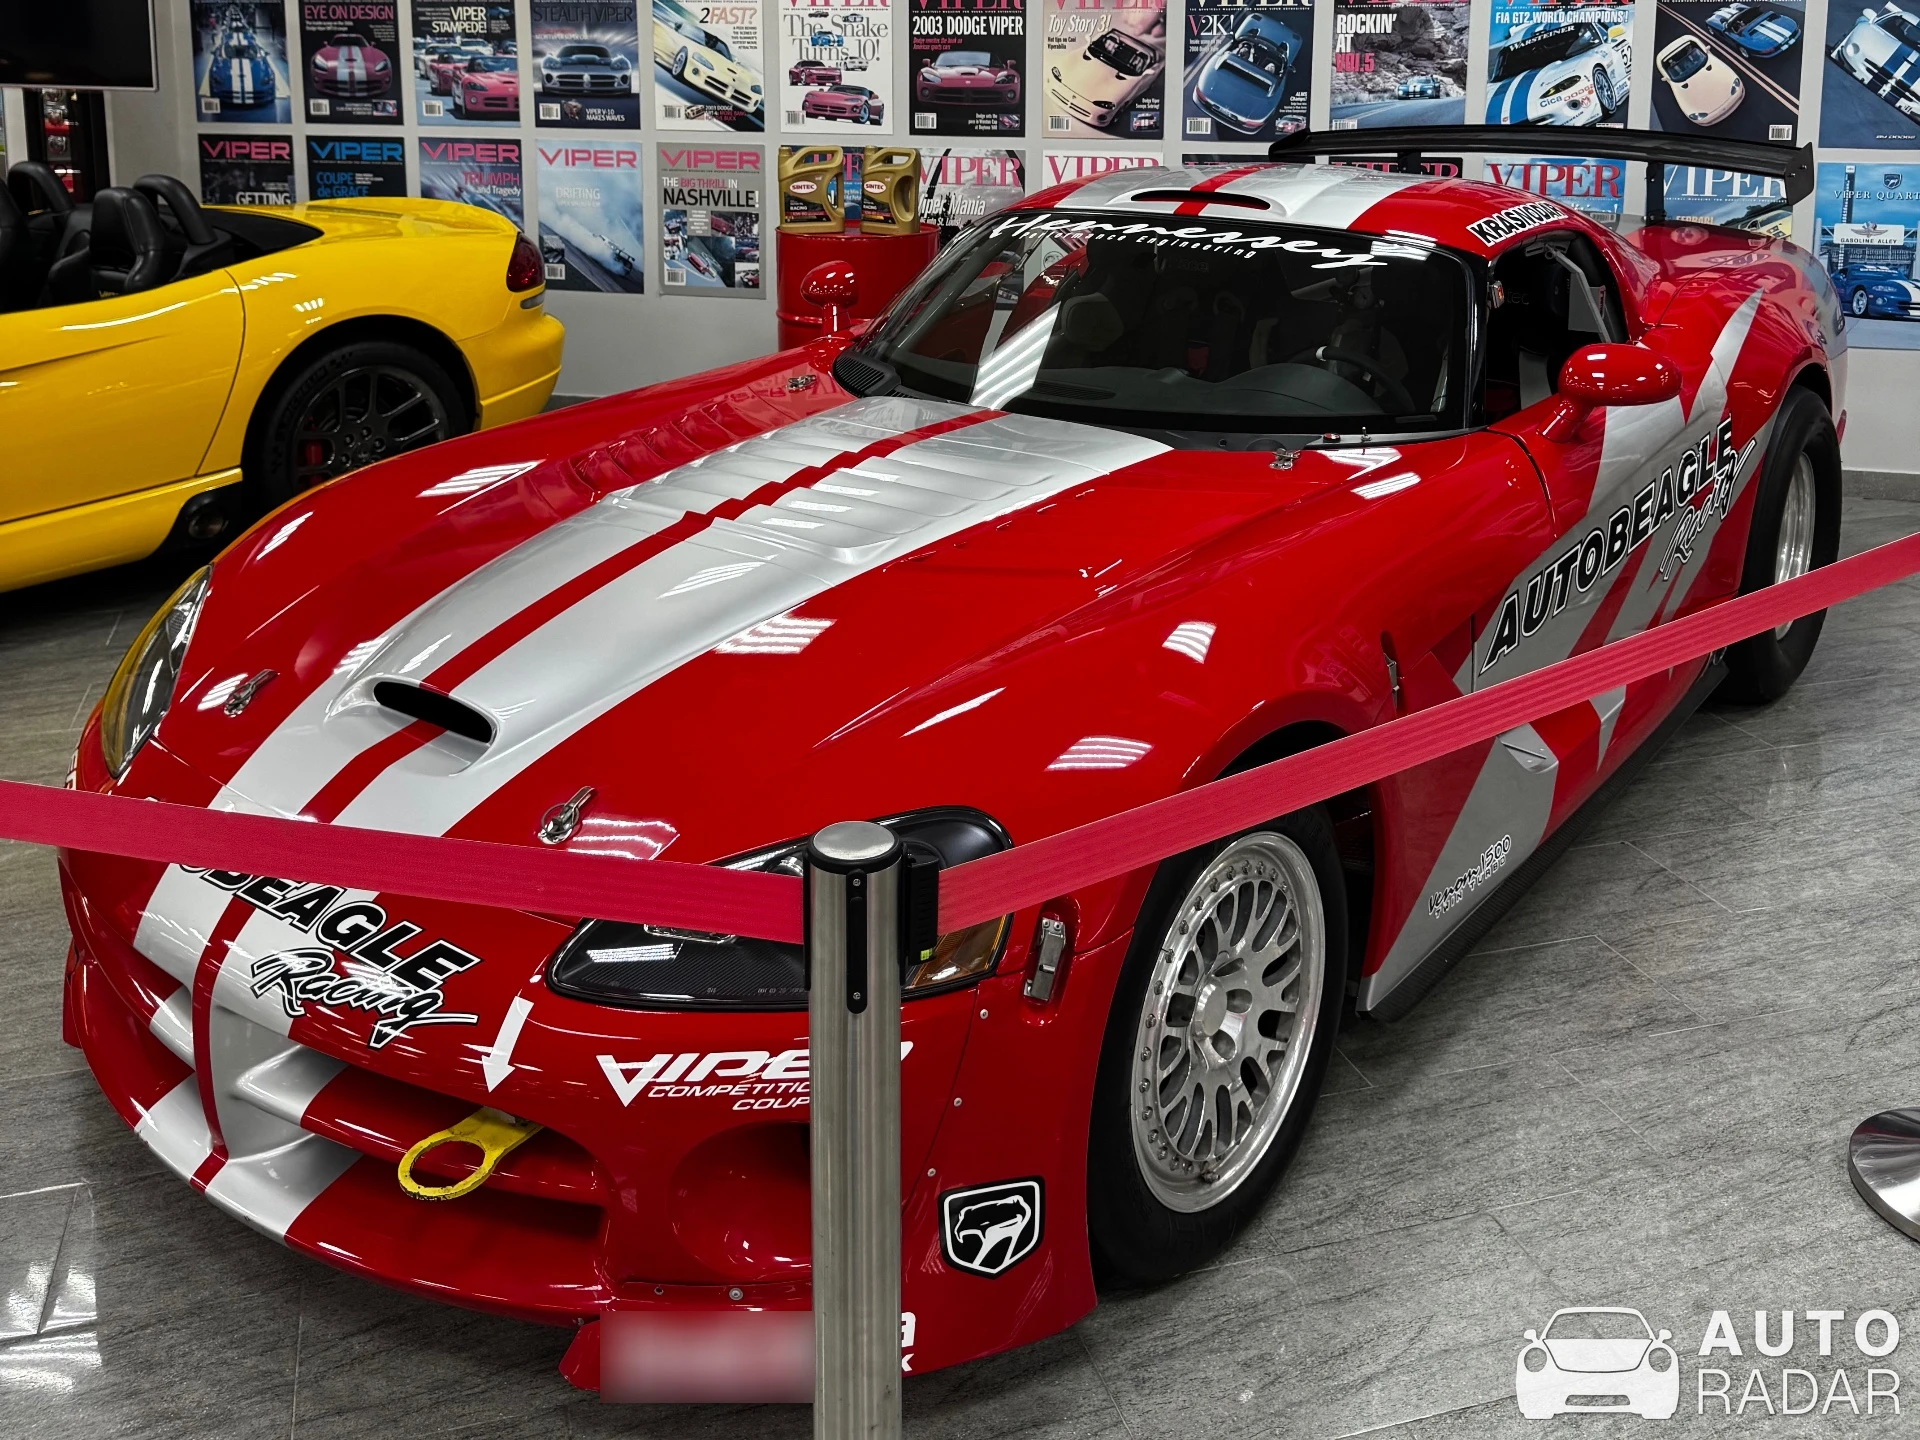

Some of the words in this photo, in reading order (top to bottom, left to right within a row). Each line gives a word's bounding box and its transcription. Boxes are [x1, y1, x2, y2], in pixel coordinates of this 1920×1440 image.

[304, 5, 328, 19] EYE
[329, 6, 349, 20] ON
[350, 6, 394, 20] DESIGN
[450, 7, 487, 20] VIPER
[533, 6, 592, 22] STEALTH
[594, 7, 633, 22] VIPER
[1495, 11, 1511, 24] FIA
[1512, 11, 1529, 24] GT2
[1532, 11, 1565, 23] WORLD
[432, 21, 488, 34] STAMPEDE!
[783, 14, 823, 37] The
[831, 14, 888, 37] Snake
[913, 16, 943, 35] 2003
[947, 16, 987, 35] DODGE
[989, 16, 1023, 35] VIPER
[1049, 14, 1066, 36] Toy
[1068, 14, 1098, 36] Story
[1098, 14, 1111, 33] 3!
[1188, 14, 1234, 36] V2K!
[1336, 14, 1397, 33] ROCKIN'
[1335, 34, 1354, 52] AT
[1509, 25, 1576, 51] WARSTEINER
[792, 38, 849, 61] Turns
[855, 38, 880, 61] 10!
[202, 140, 291, 160] VIPER
[309, 141, 403, 161] VIPER
[421, 142, 520, 163] VIPER
[538, 147, 637, 169] VIPER
[660, 149, 760, 170] VIPER
[316, 172, 354, 185] COUPE
[463, 171, 520, 186] TRIUMPH
[920, 156, 1022, 187] VIPER
[1486, 163, 1624, 198] VIPER
[317, 185, 331, 197] de
[332, 186, 369, 197] GRACE
[492, 185, 521, 197] Tragedy
[662, 177, 679, 187] THE
[680, 178, 695, 188] BIG
[697, 179, 727, 188] THRILL
[728, 179, 738, 188] IN
[236, 191, 291, 205] GETTING
[556, 187, 600, 200] DRIFTING
[663, 188, 759, 208] NASHVILLE!
[1834, 190, 1871, 200] VIPER
[948, 194, 985, 216] Mania
[989, 213, 1388, 269] Hennessey
[1018, 231, 1127, 242] Performance
[1135, 235, 1257, 259] Engineering
[1659, 438, 1757, 582] Racing
[1477, 412, 1734, 677] AUTOBEAGLE
[1469, 855, 1506, 891] TURBO
[179, 864, 484, 992] EAGLE
[251, 947, 480, 1049] Racing
[596, 1041, 914, 1108] VIPE
